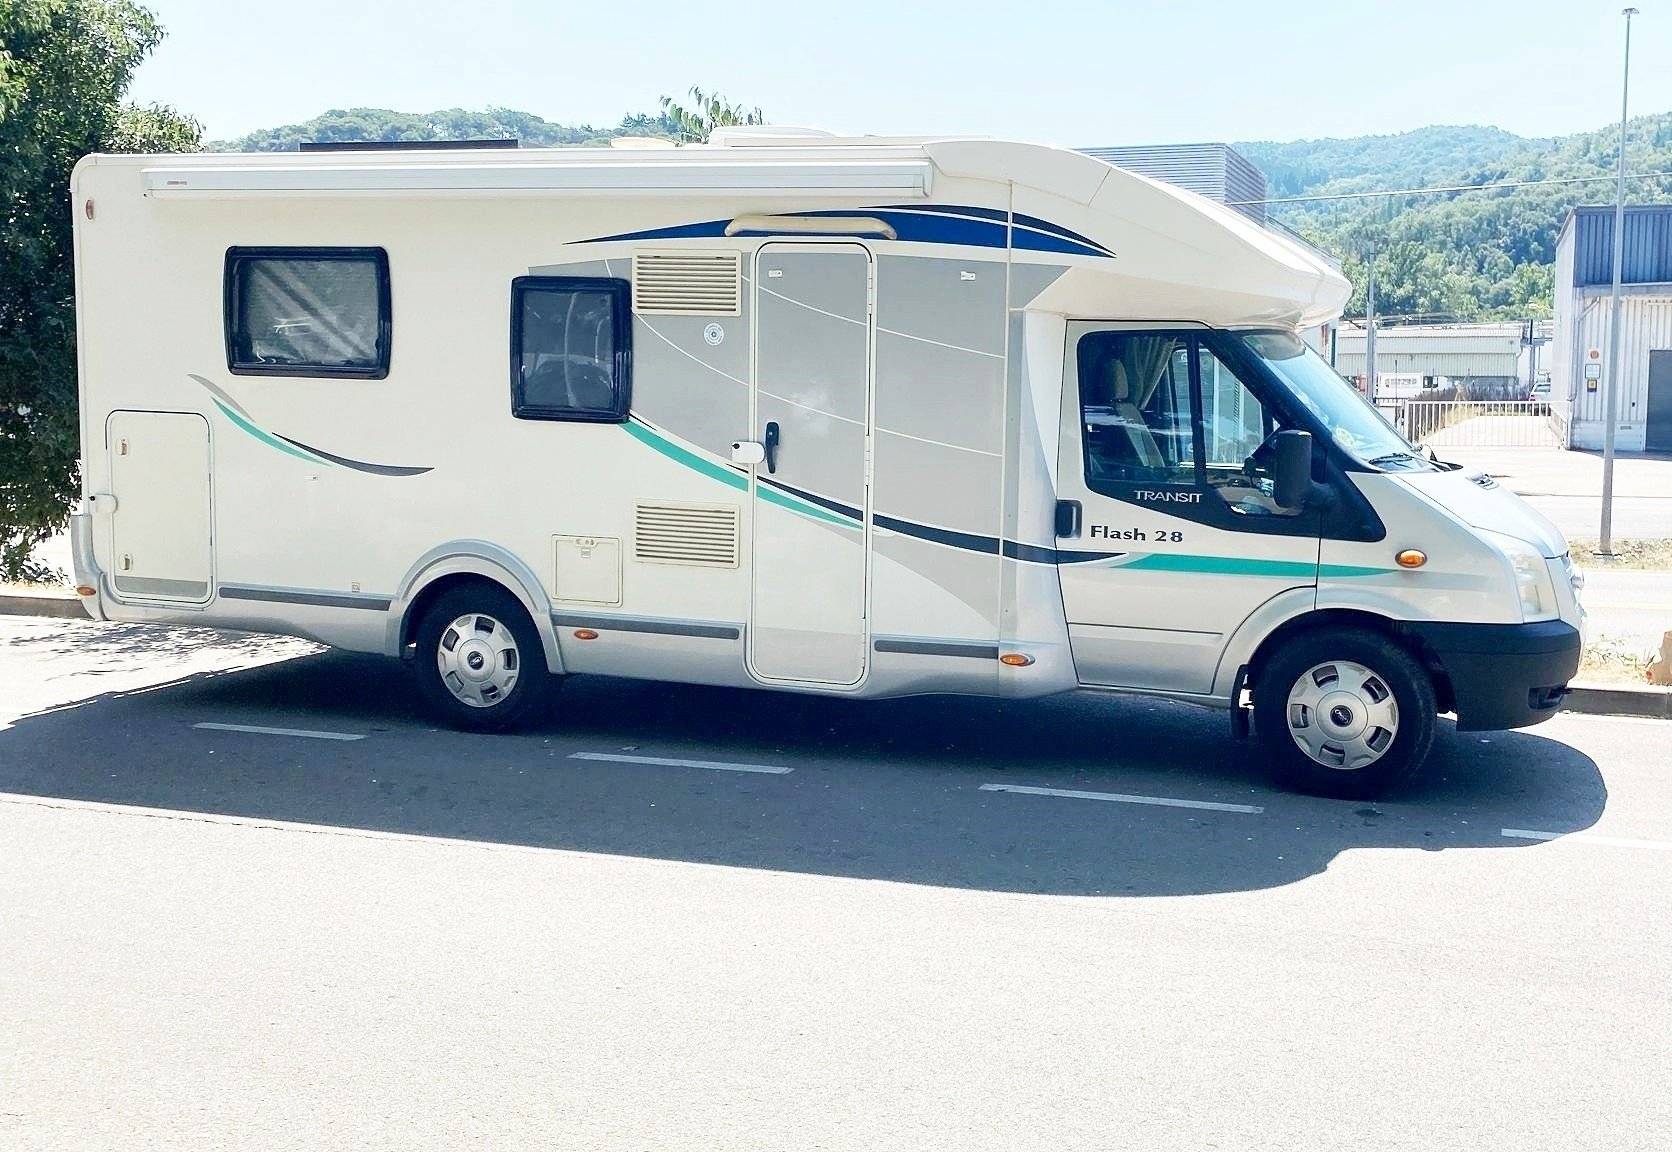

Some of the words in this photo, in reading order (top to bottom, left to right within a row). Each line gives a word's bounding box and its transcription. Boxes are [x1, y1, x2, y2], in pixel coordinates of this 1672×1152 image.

[1134, 490, 1203, 503] TRANSIT
[1090, 525, 1146, 541] Flash
[1154, 530, 1183, 542] 28
